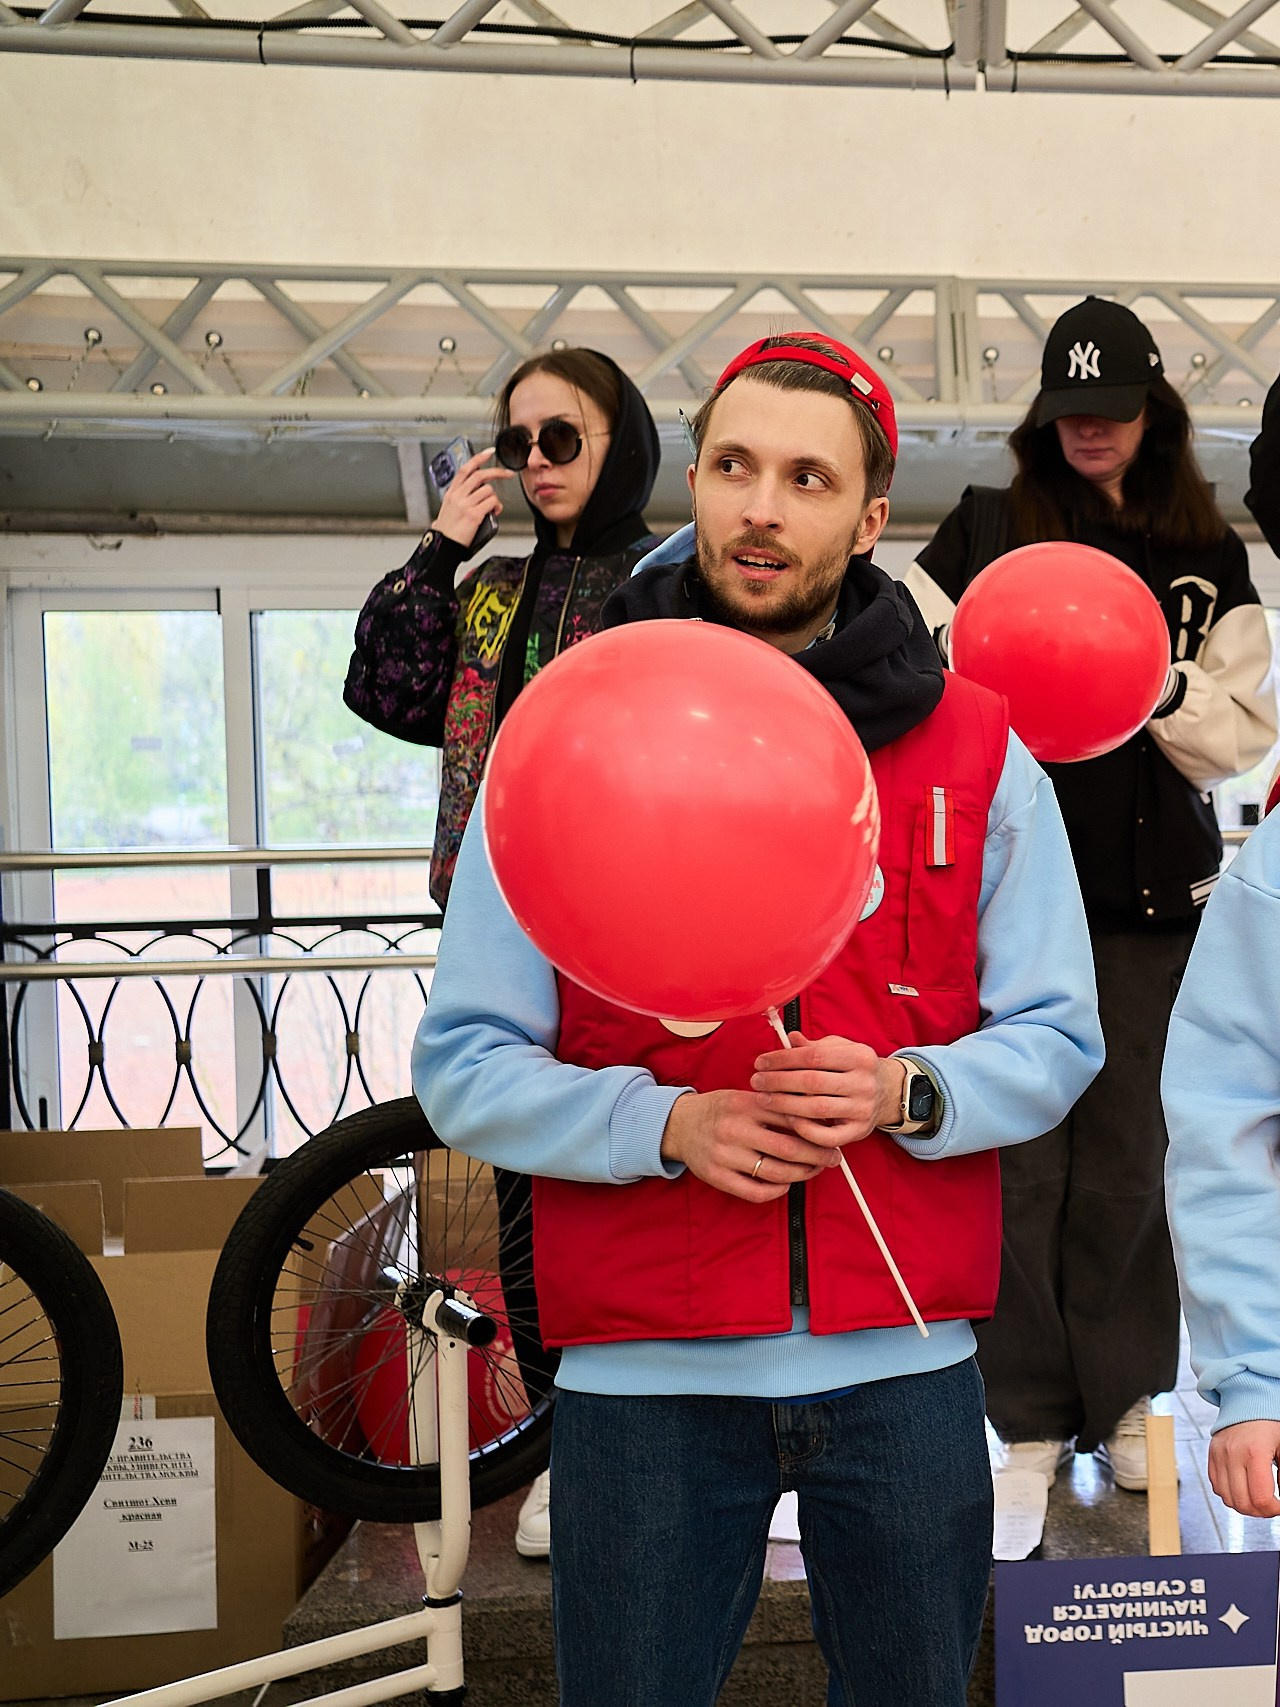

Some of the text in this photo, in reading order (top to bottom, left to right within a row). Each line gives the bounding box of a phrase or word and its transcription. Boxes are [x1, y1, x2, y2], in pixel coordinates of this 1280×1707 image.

[1068, 341, 1101, 380] NY
[129, 1436, 153, 1450] 236
[117, 1452, 192, 1462] ПРАВИТЕЛЬСТВА
[129, 1540, 154, 1550] М-25
[1073, 1579, 1206, 1600] В СУББОТУ!
[1053, 1599, 1207, 1621] НАЧИНАЕТСЯ
[1024, 1620, 1209, 1644] ЧИСТЫЙ ГОРОД
